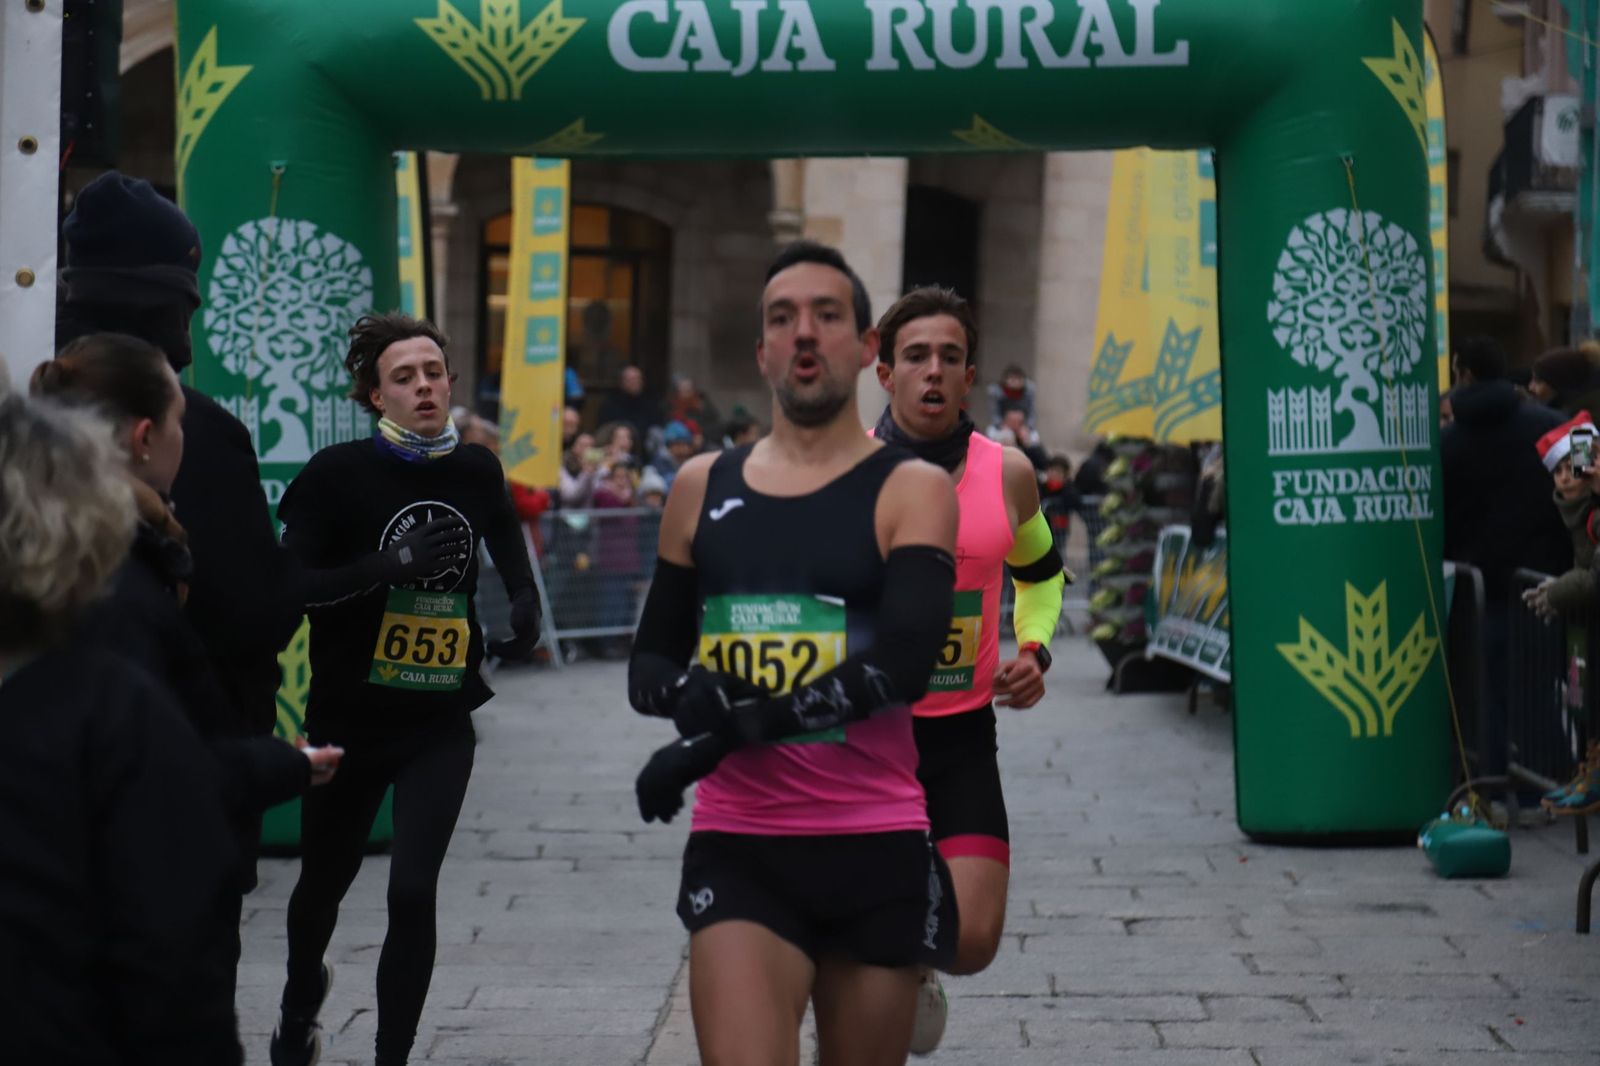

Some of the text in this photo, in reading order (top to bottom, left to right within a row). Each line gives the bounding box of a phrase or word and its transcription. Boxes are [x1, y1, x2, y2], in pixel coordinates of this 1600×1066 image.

[606, 0, 1190, 77] CAJA RURAL
[1272, 465, 1432, 496] FUNDACION
[1273, 494, 1434, 526] CAJA RURAL
[383, 623, 459, 665] 653
[939, 628, 964, 666] 5
[400, 671, 459, 684] CAJA RURAL
[707, 639, 819, 695] 1052
[929, 673, 968, 685] RURAL
